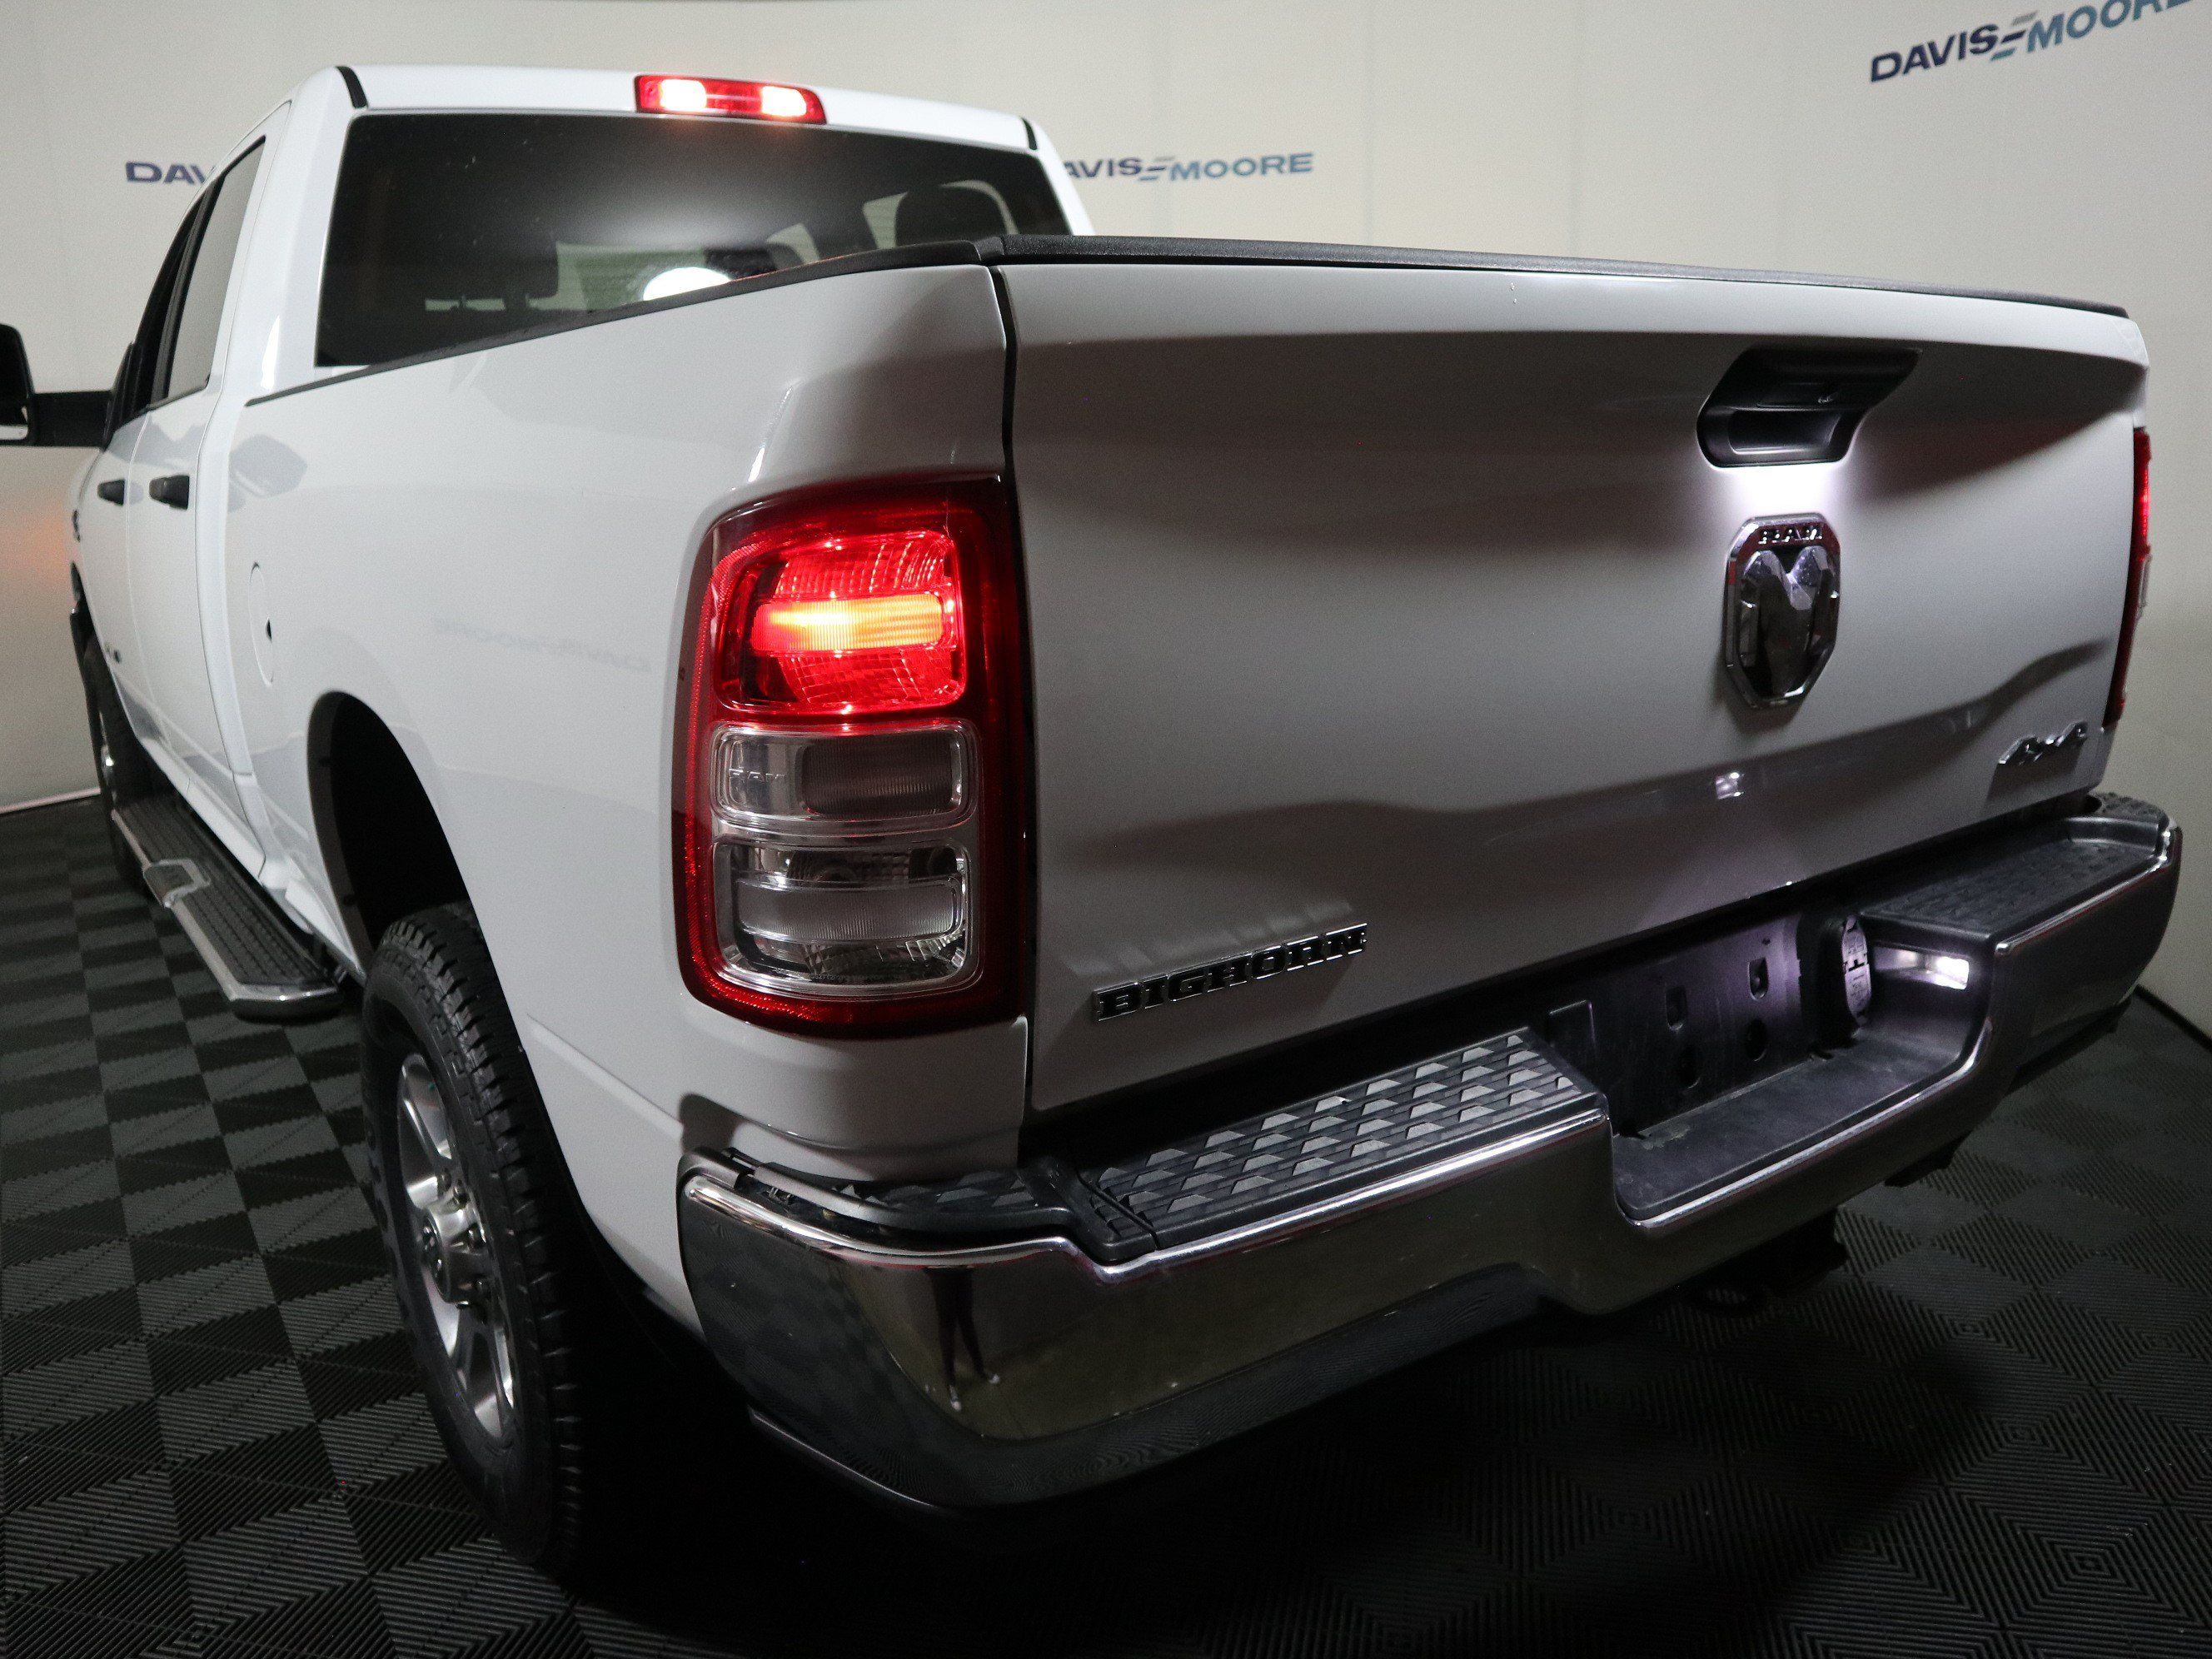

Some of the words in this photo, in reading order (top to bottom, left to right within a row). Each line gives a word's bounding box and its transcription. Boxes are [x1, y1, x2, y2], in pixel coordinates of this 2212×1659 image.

[1870, 23, 2000, 82] DAVIS
[2026, 0, 2195, 54] MOOR
[125, 161, 213, 185] DAV
[1064, 157, 1143, 178] AVIS
[1169, 152, 1314, 181] MOORE
[1757, 526, 1823, 545] RAM
